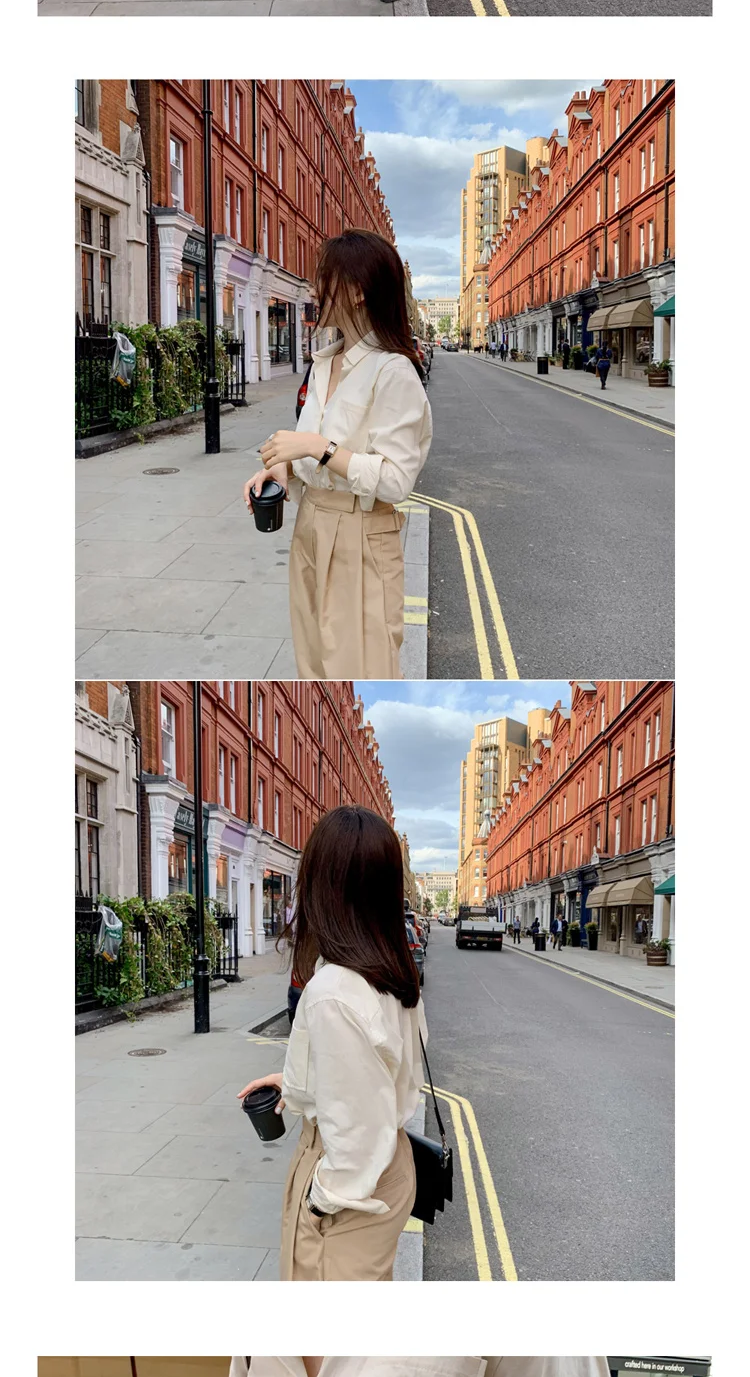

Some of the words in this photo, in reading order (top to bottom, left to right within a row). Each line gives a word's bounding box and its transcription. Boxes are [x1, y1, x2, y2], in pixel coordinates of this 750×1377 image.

[624, 1360, 640, 1369] crafted
[641, 1361, 651, 1370] here
[652, 1362, 656, 1370] in
[664, 1364, 685, 1373] workshop
